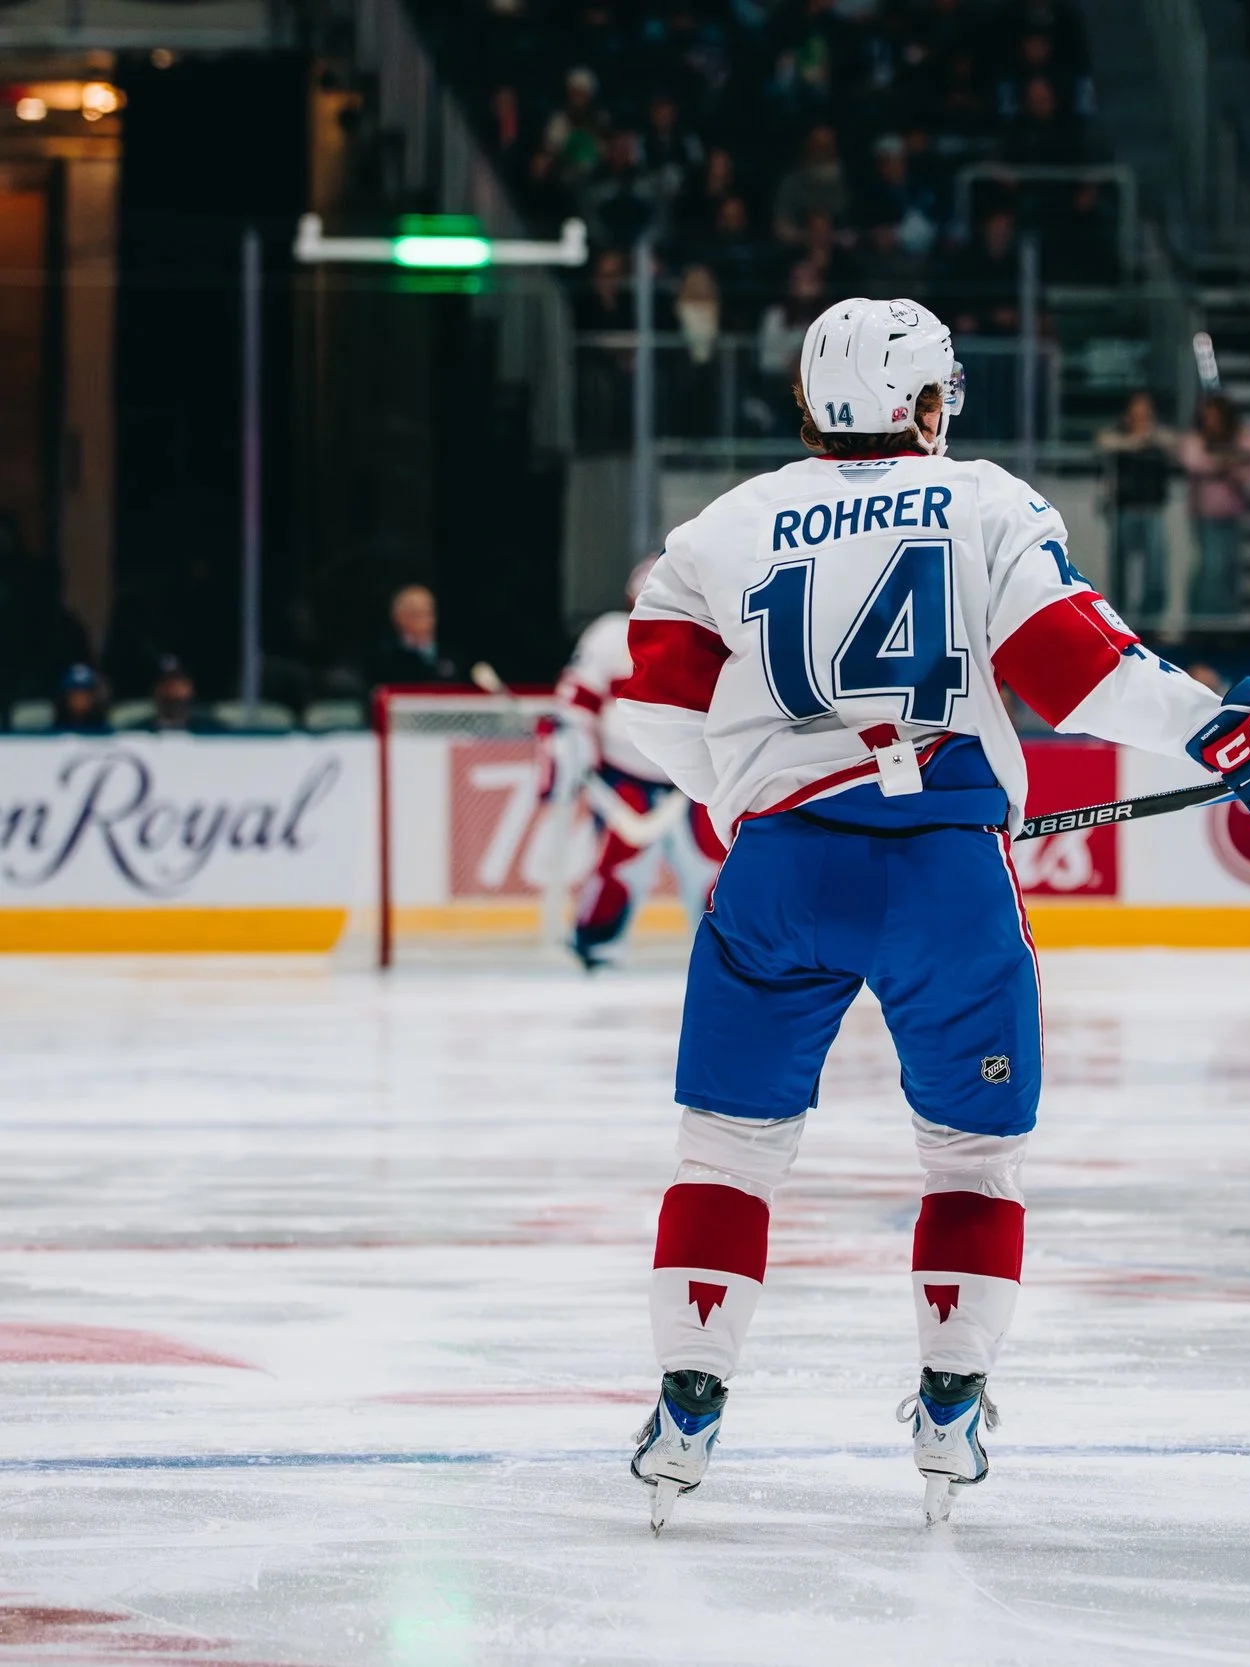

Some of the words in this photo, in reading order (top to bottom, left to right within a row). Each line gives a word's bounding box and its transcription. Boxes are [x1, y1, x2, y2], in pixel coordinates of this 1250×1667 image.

[824, 402, 854, 427] 14
[773, 486, 952, 551] ROHRER
[742, 539, 968, 727] 14
[3, 750, 343, 898] Royal
[1039, 803, 1133, 835] BAUER
[987, 1061, 1005, 1077] NHL
